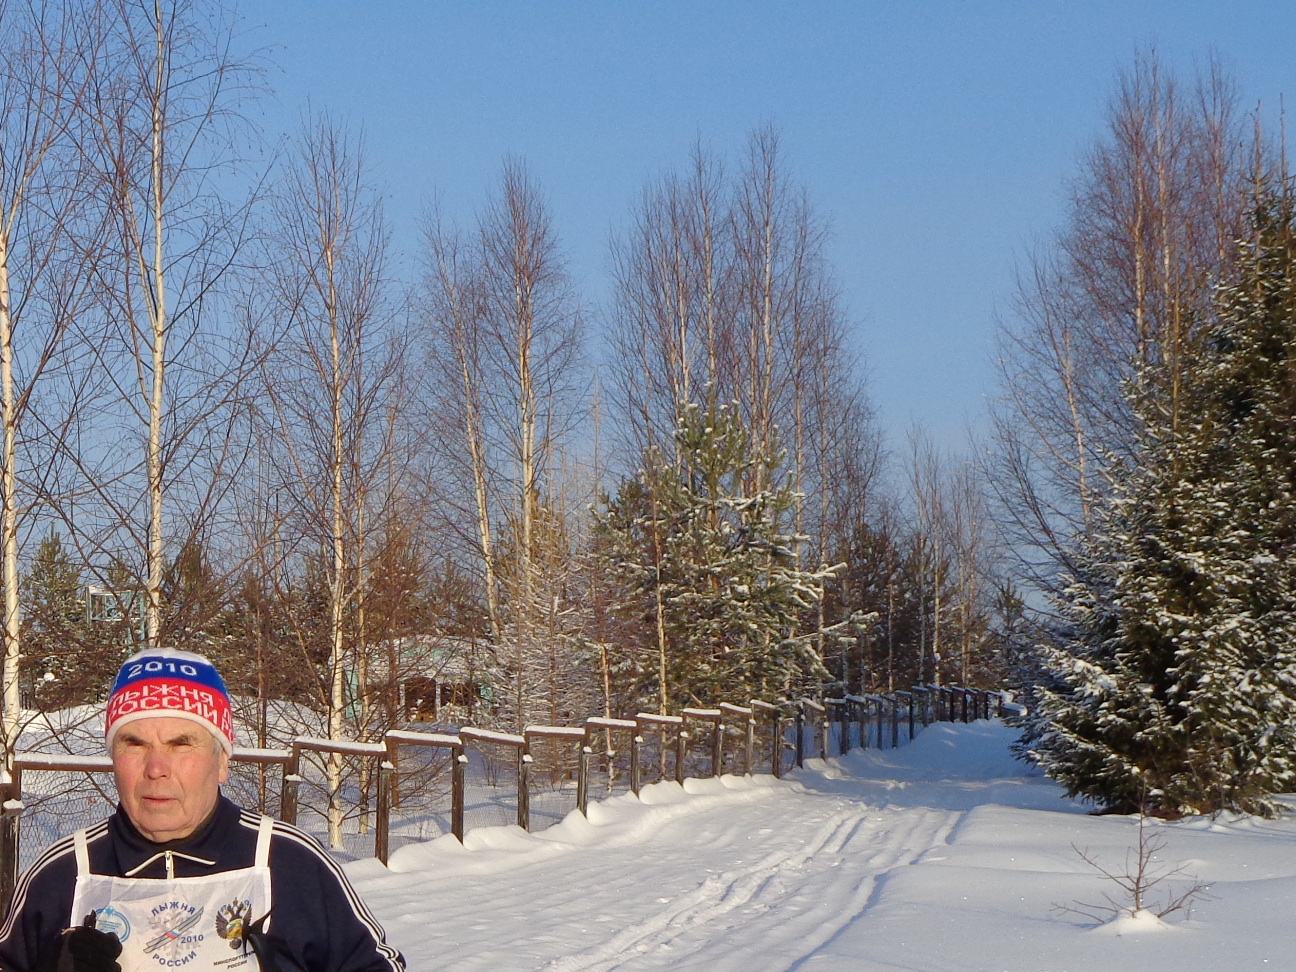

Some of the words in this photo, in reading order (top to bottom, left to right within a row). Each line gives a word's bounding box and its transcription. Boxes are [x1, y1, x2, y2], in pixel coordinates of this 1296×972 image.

[127, 661, 198, 679] 2010
[110, 684, 214, 710] ЛЫЖНЯ
[109, 696, 218, 727] РОССИИ
[151, 902, 195, 916] ЛЫЖНЯ
[181, 934, 204, 943] 2010
[152, 951, 197, 967] РОССИИ
